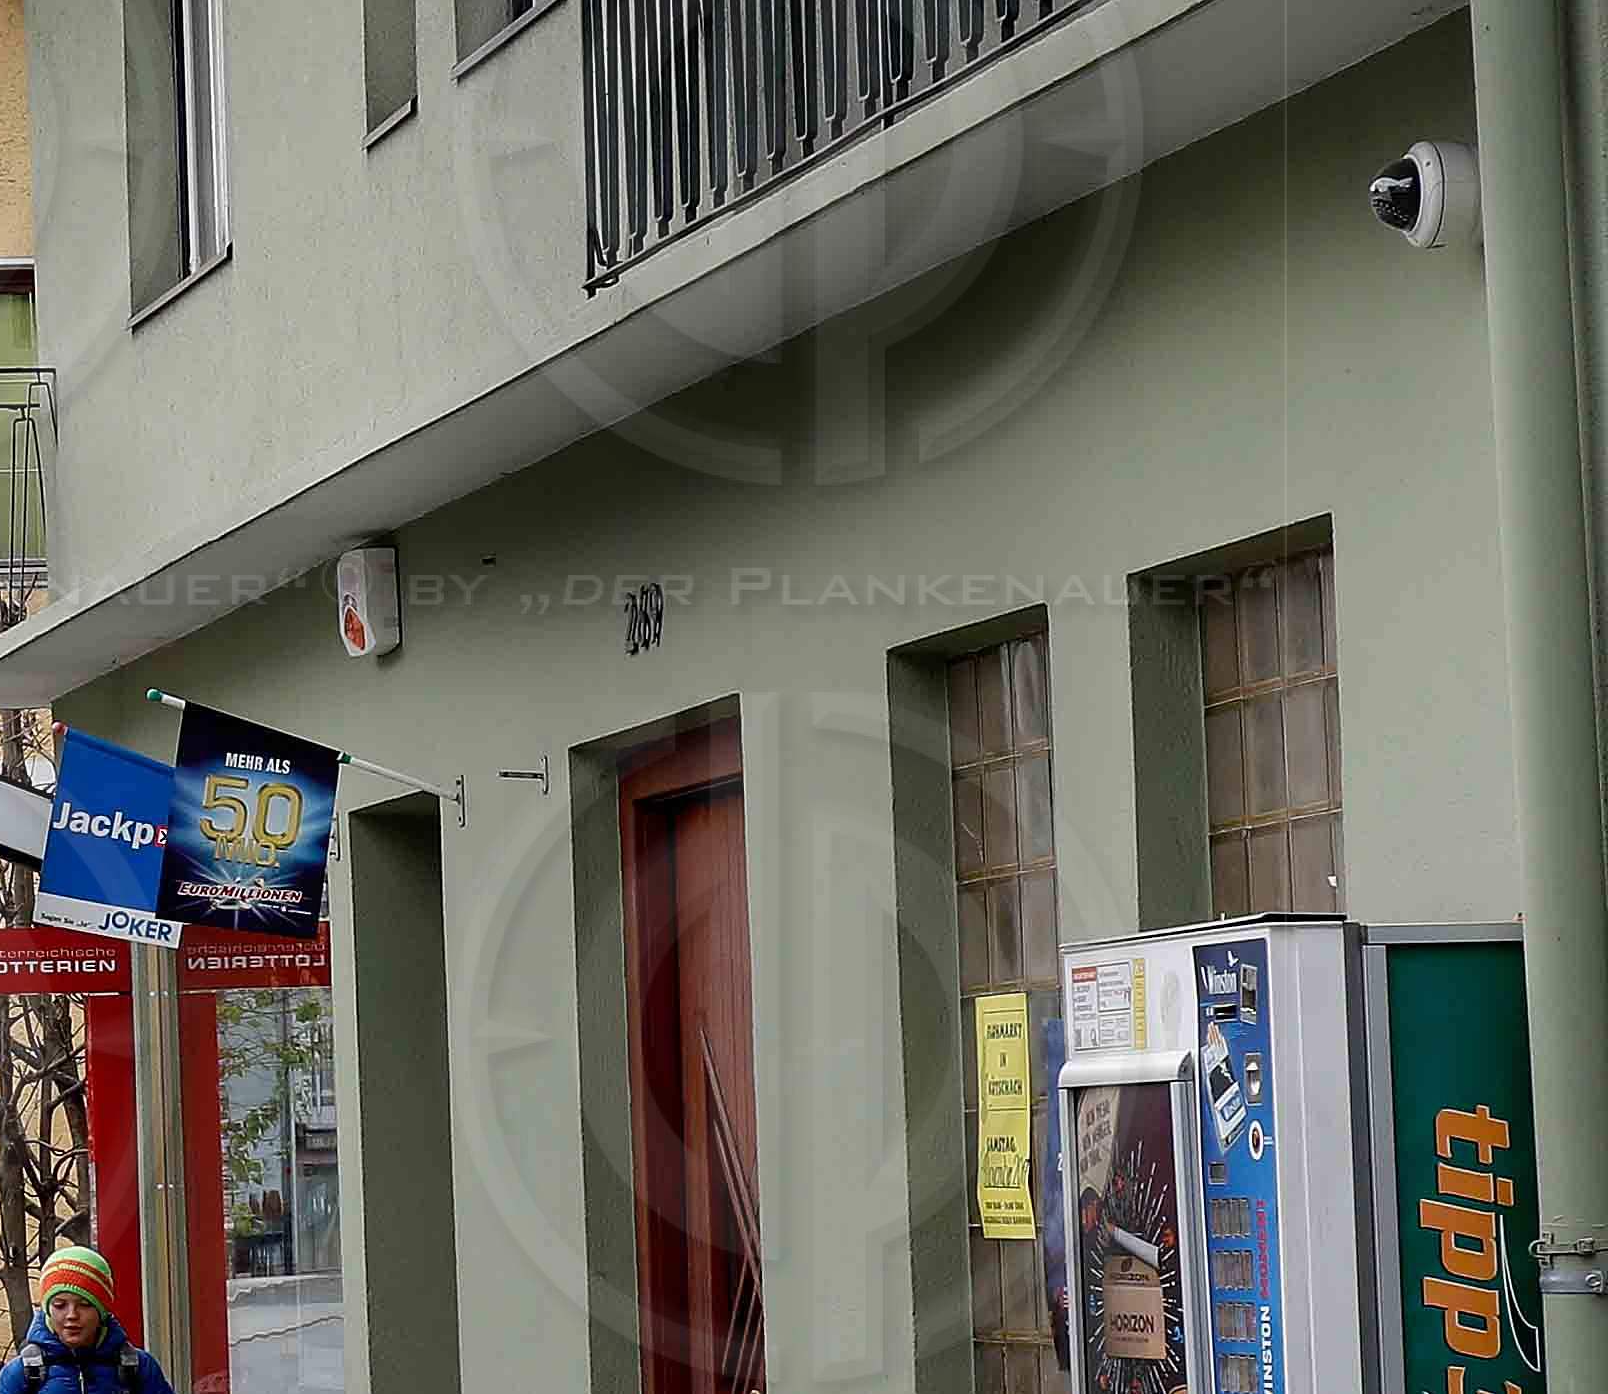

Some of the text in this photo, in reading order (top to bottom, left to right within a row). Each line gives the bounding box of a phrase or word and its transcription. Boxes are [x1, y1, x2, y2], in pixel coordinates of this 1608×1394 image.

[225, 752, 292, 776] MEHR ALS
[199, 773, 304, 850] 50
[97, 909, 173, 942] JOKER
[1200, 964, 1238, 996] Winston
[1110, 1312, 1155, 1334] HORIZON
